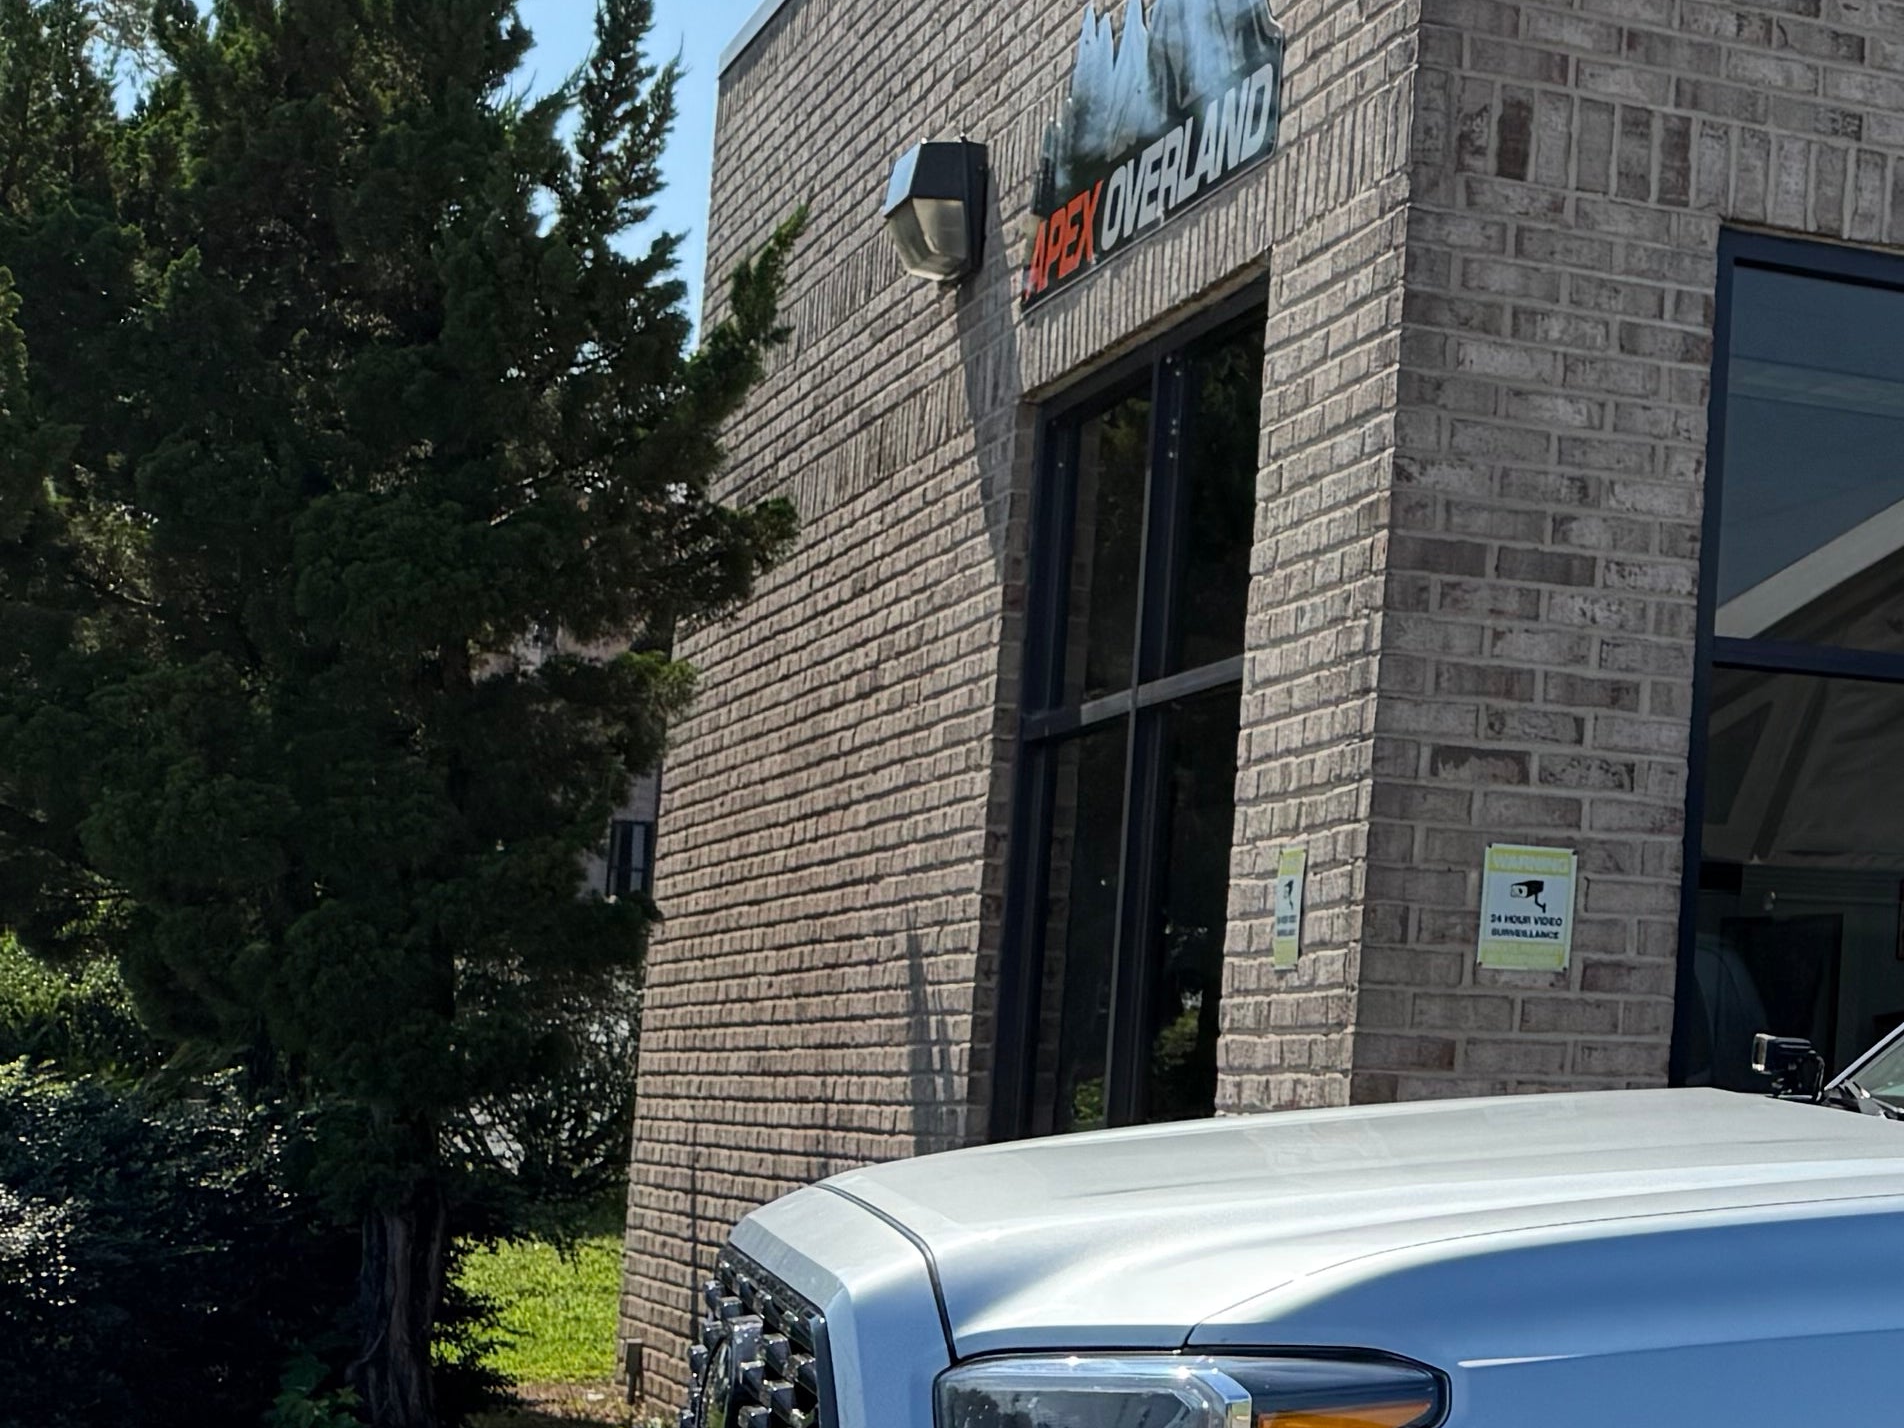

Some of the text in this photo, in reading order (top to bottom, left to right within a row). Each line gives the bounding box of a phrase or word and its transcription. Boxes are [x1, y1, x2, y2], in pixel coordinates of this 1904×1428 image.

[1025, 63, 1274, 302] APEX OVERLAND
[1504, 914, 1532, 925] HOUR
[1534, 916, 1563, 926] VIDEO
[1491, 928, 1560, 939] SURVEILLANCE
